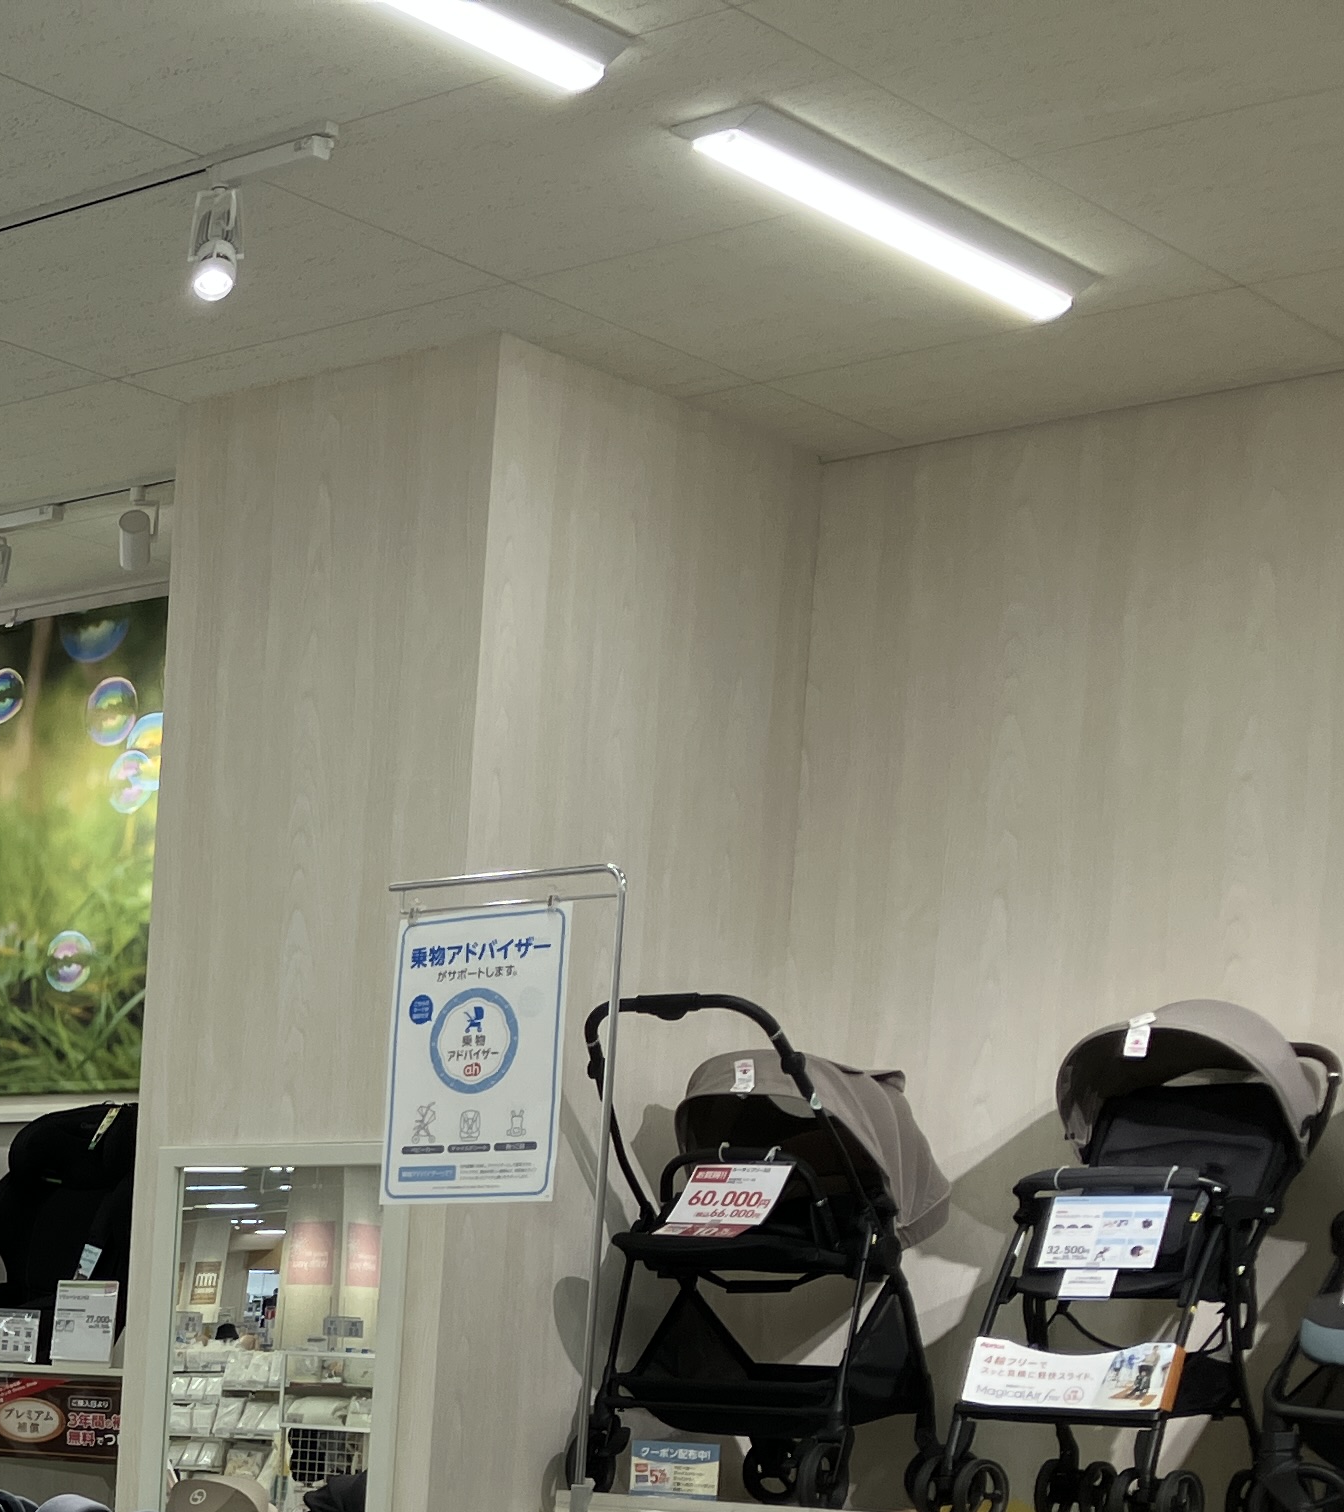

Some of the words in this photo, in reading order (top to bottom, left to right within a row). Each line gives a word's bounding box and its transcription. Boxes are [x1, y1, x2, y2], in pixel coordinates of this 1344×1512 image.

[410, 936, 552, 968] 乗物アドバイザー
[688, 1190, 772, 1209] 60,000円
[4, 1409, 54, 1423] プレミアム
